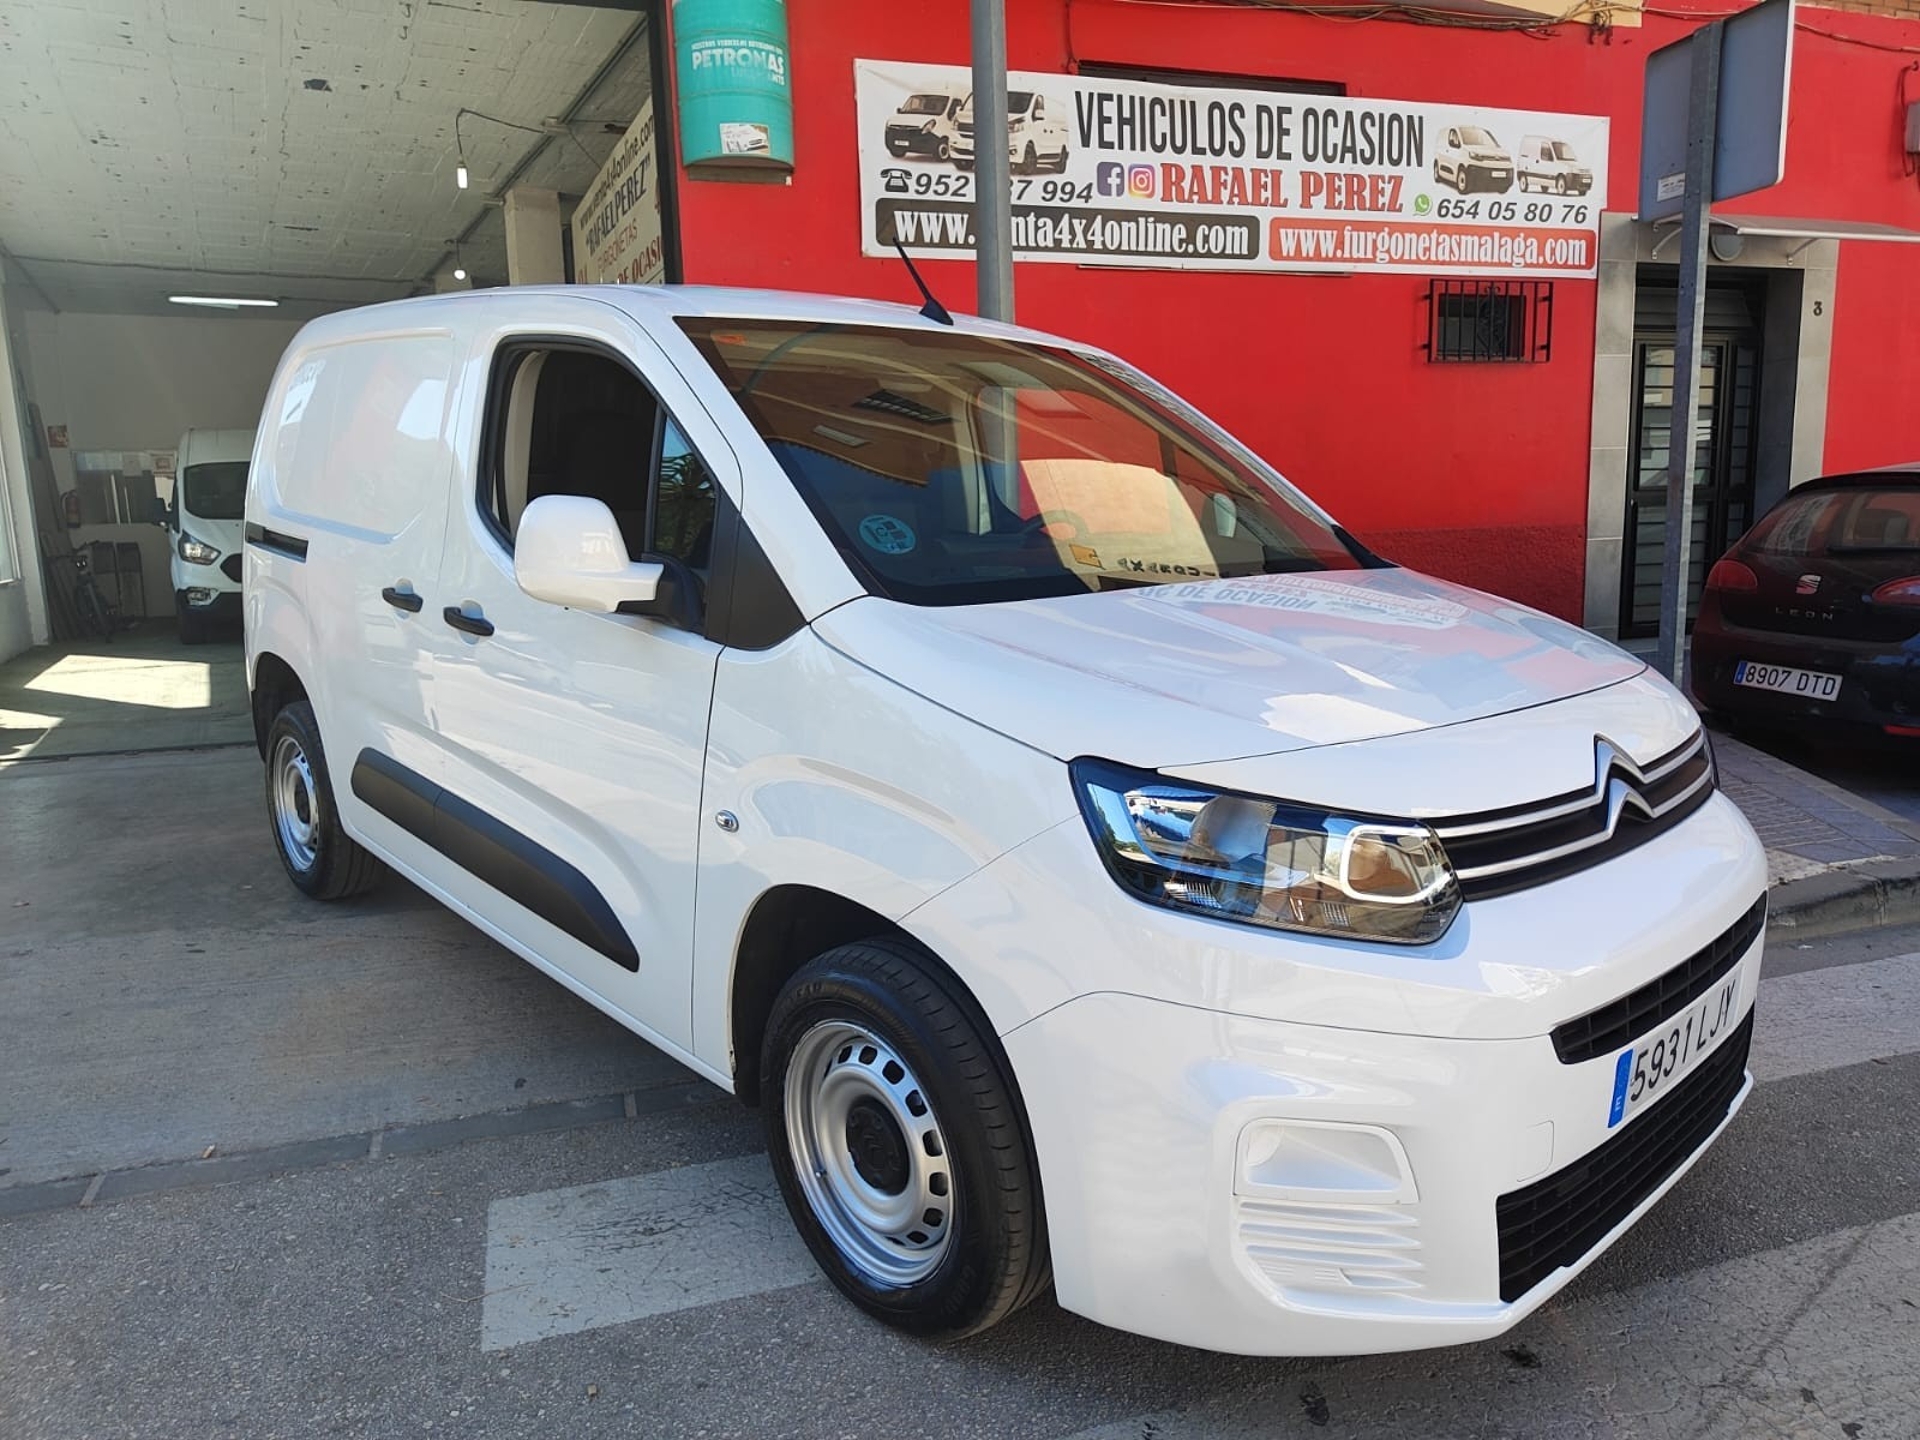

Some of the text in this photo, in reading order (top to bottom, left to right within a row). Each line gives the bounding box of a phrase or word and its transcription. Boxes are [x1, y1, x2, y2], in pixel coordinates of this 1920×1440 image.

[692, 47, 785, 75] PETRONAS
[1075, 91, 1423, 167] VEHICULOS DE OCASION
[914, 173, 970, 197] 952
[1041, 181, 1094, 203] 994
[1160, 163, 1403, 212] RAFAEL PEREZ
[1437, 199, 1588, 224] 654 05 80 76
[893, 211, 1249, 255] www.nta4x4online.com
[1279, 225, 1586, 270] www.furgonetasmalaga.com
[1813, 300, 1823, 317] 3
[1775, 606, 1834, 621] LEON
[1745, 665, 1836, 696] 8907 DTD
[1630, 1017, 1692, 1102] 5931
